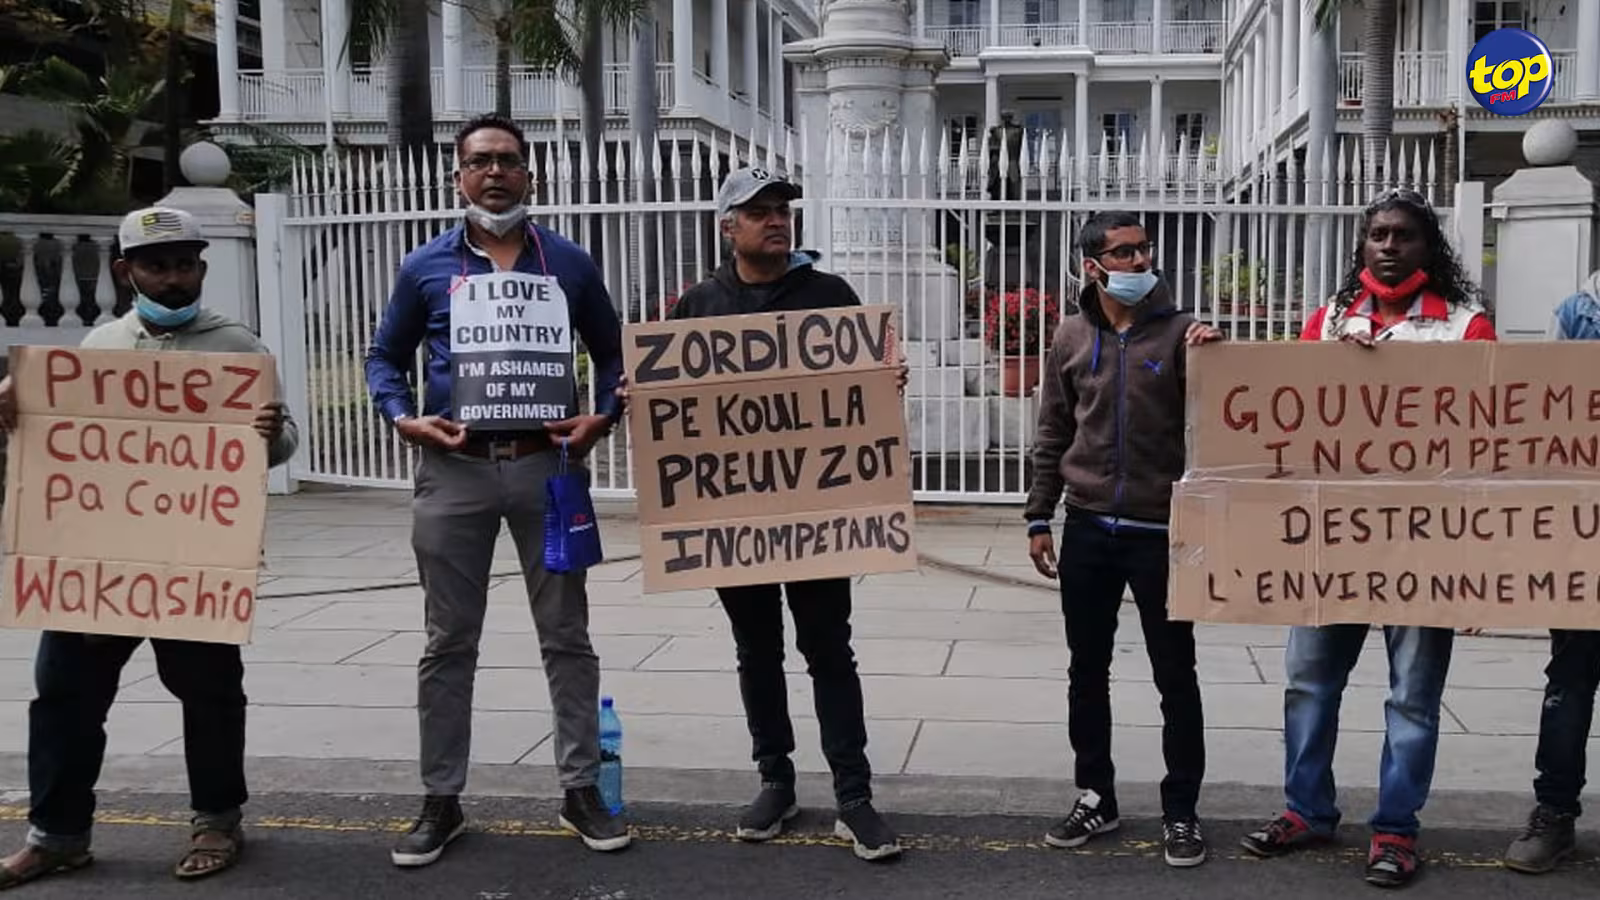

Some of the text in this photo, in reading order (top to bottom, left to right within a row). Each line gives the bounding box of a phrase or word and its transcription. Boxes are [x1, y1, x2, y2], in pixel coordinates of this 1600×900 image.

[469, 280, 551, 301] I LOVE
[496, 305, 526, 319] MY
[456, 325, 564, 344] COUNTRY
[798, 312, 893, 371] GOV
[458, 361, 565, 377] I'M ASHAMED
[486, 382, 537, 398] OF MY
[460, 405, 567, 421] GOVERNMENT
[649, 384, 866, 441] PE KOUL LA
[657, 436, 900, 509] PREUV ZOT
[661, 511, 911, 574] INCOMPETANS
[1208, 569, 1600, 606] L'ENVIRONNEME
